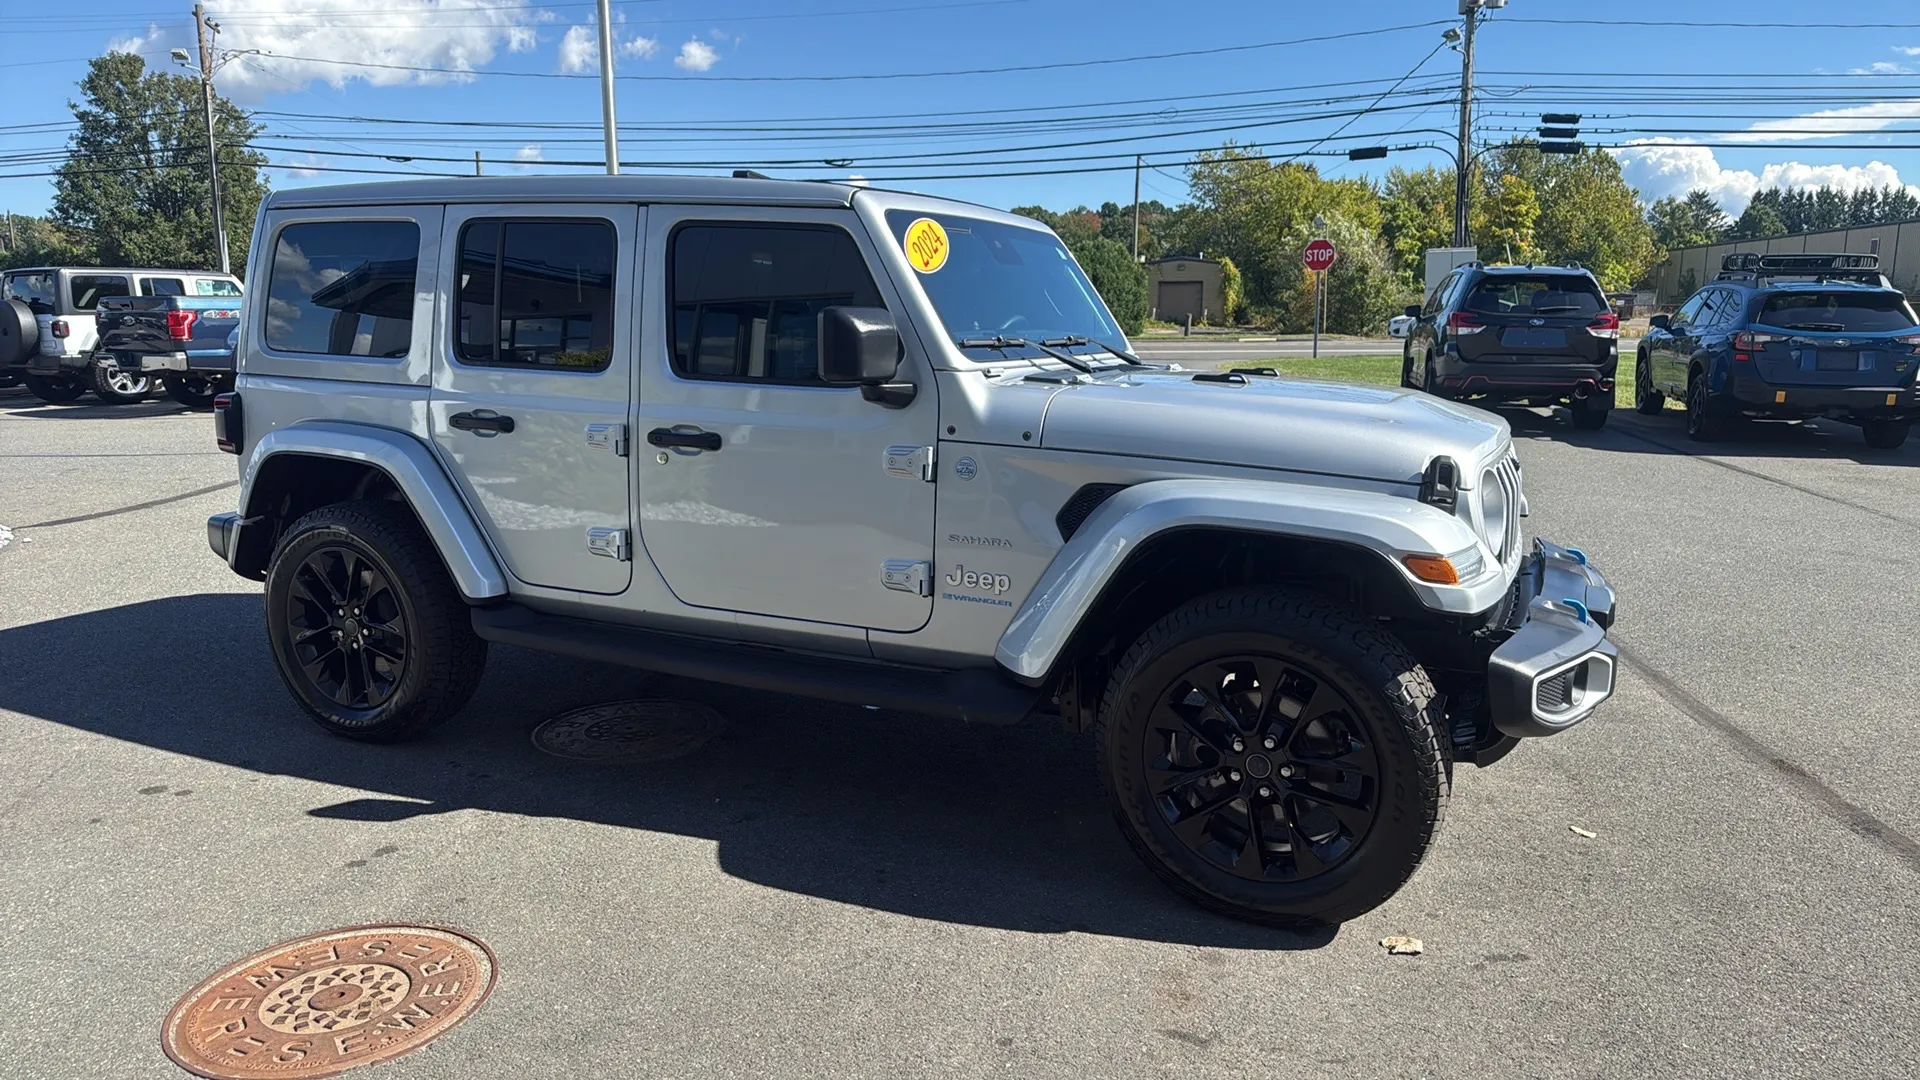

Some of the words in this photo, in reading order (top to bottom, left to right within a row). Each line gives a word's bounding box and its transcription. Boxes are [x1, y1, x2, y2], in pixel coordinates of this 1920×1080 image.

[911, 223, 943, 267] 2024
[1306, 249, 1333, 262] STOP
[949, 534, 1013, 548] SAHARA
[945, 564, 1011, 596] Jeep
[952, 594, 1013, 608] WRANGLER
